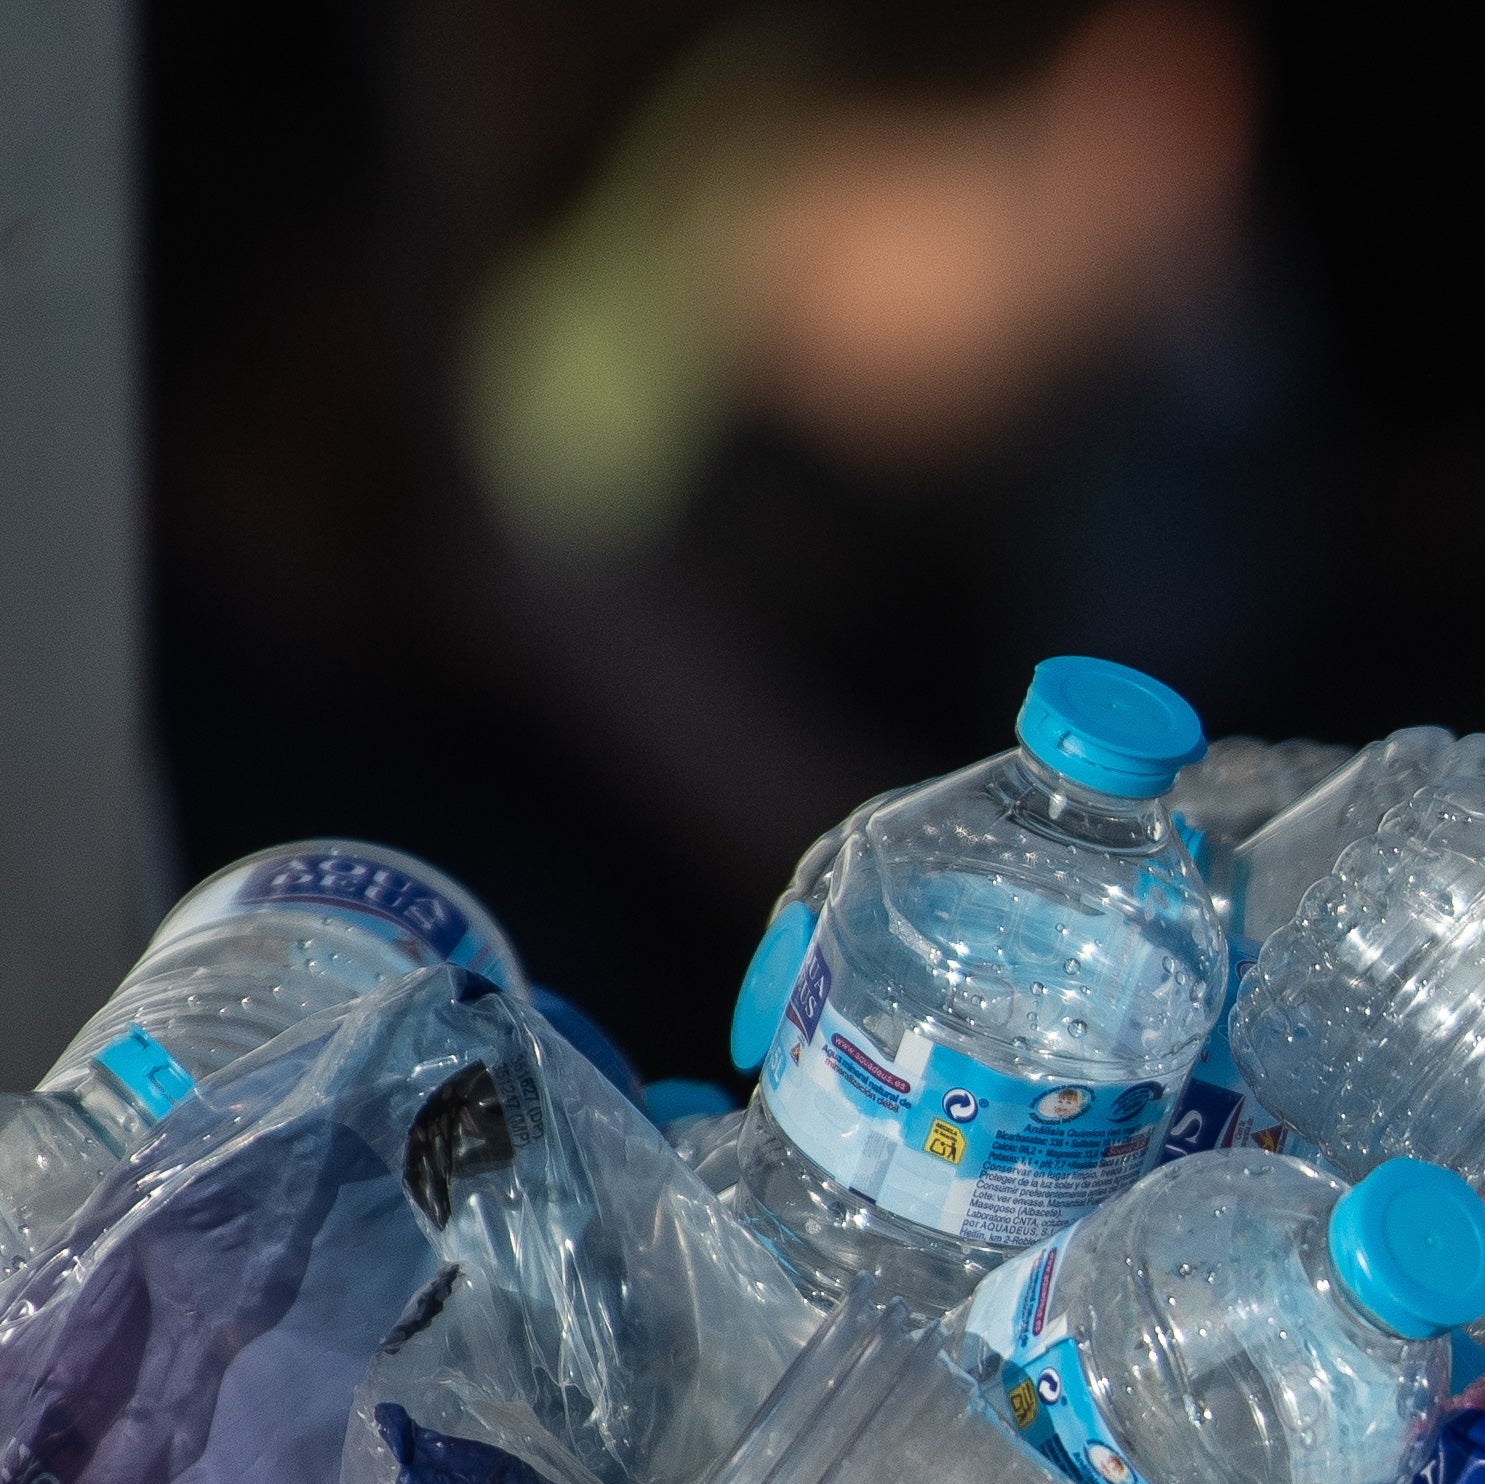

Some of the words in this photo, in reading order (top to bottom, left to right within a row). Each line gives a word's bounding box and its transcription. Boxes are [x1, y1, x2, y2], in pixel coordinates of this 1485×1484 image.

[982, 1161, 1031, 1178] Conservar
[979, 1170, 1016, 1188] Proteger
[1016, 1176, 1029, 1187] de
[976, 1180, 1018, 1196] Consumir
[980, 1220, 1038, 1237] AQUADEUS,
